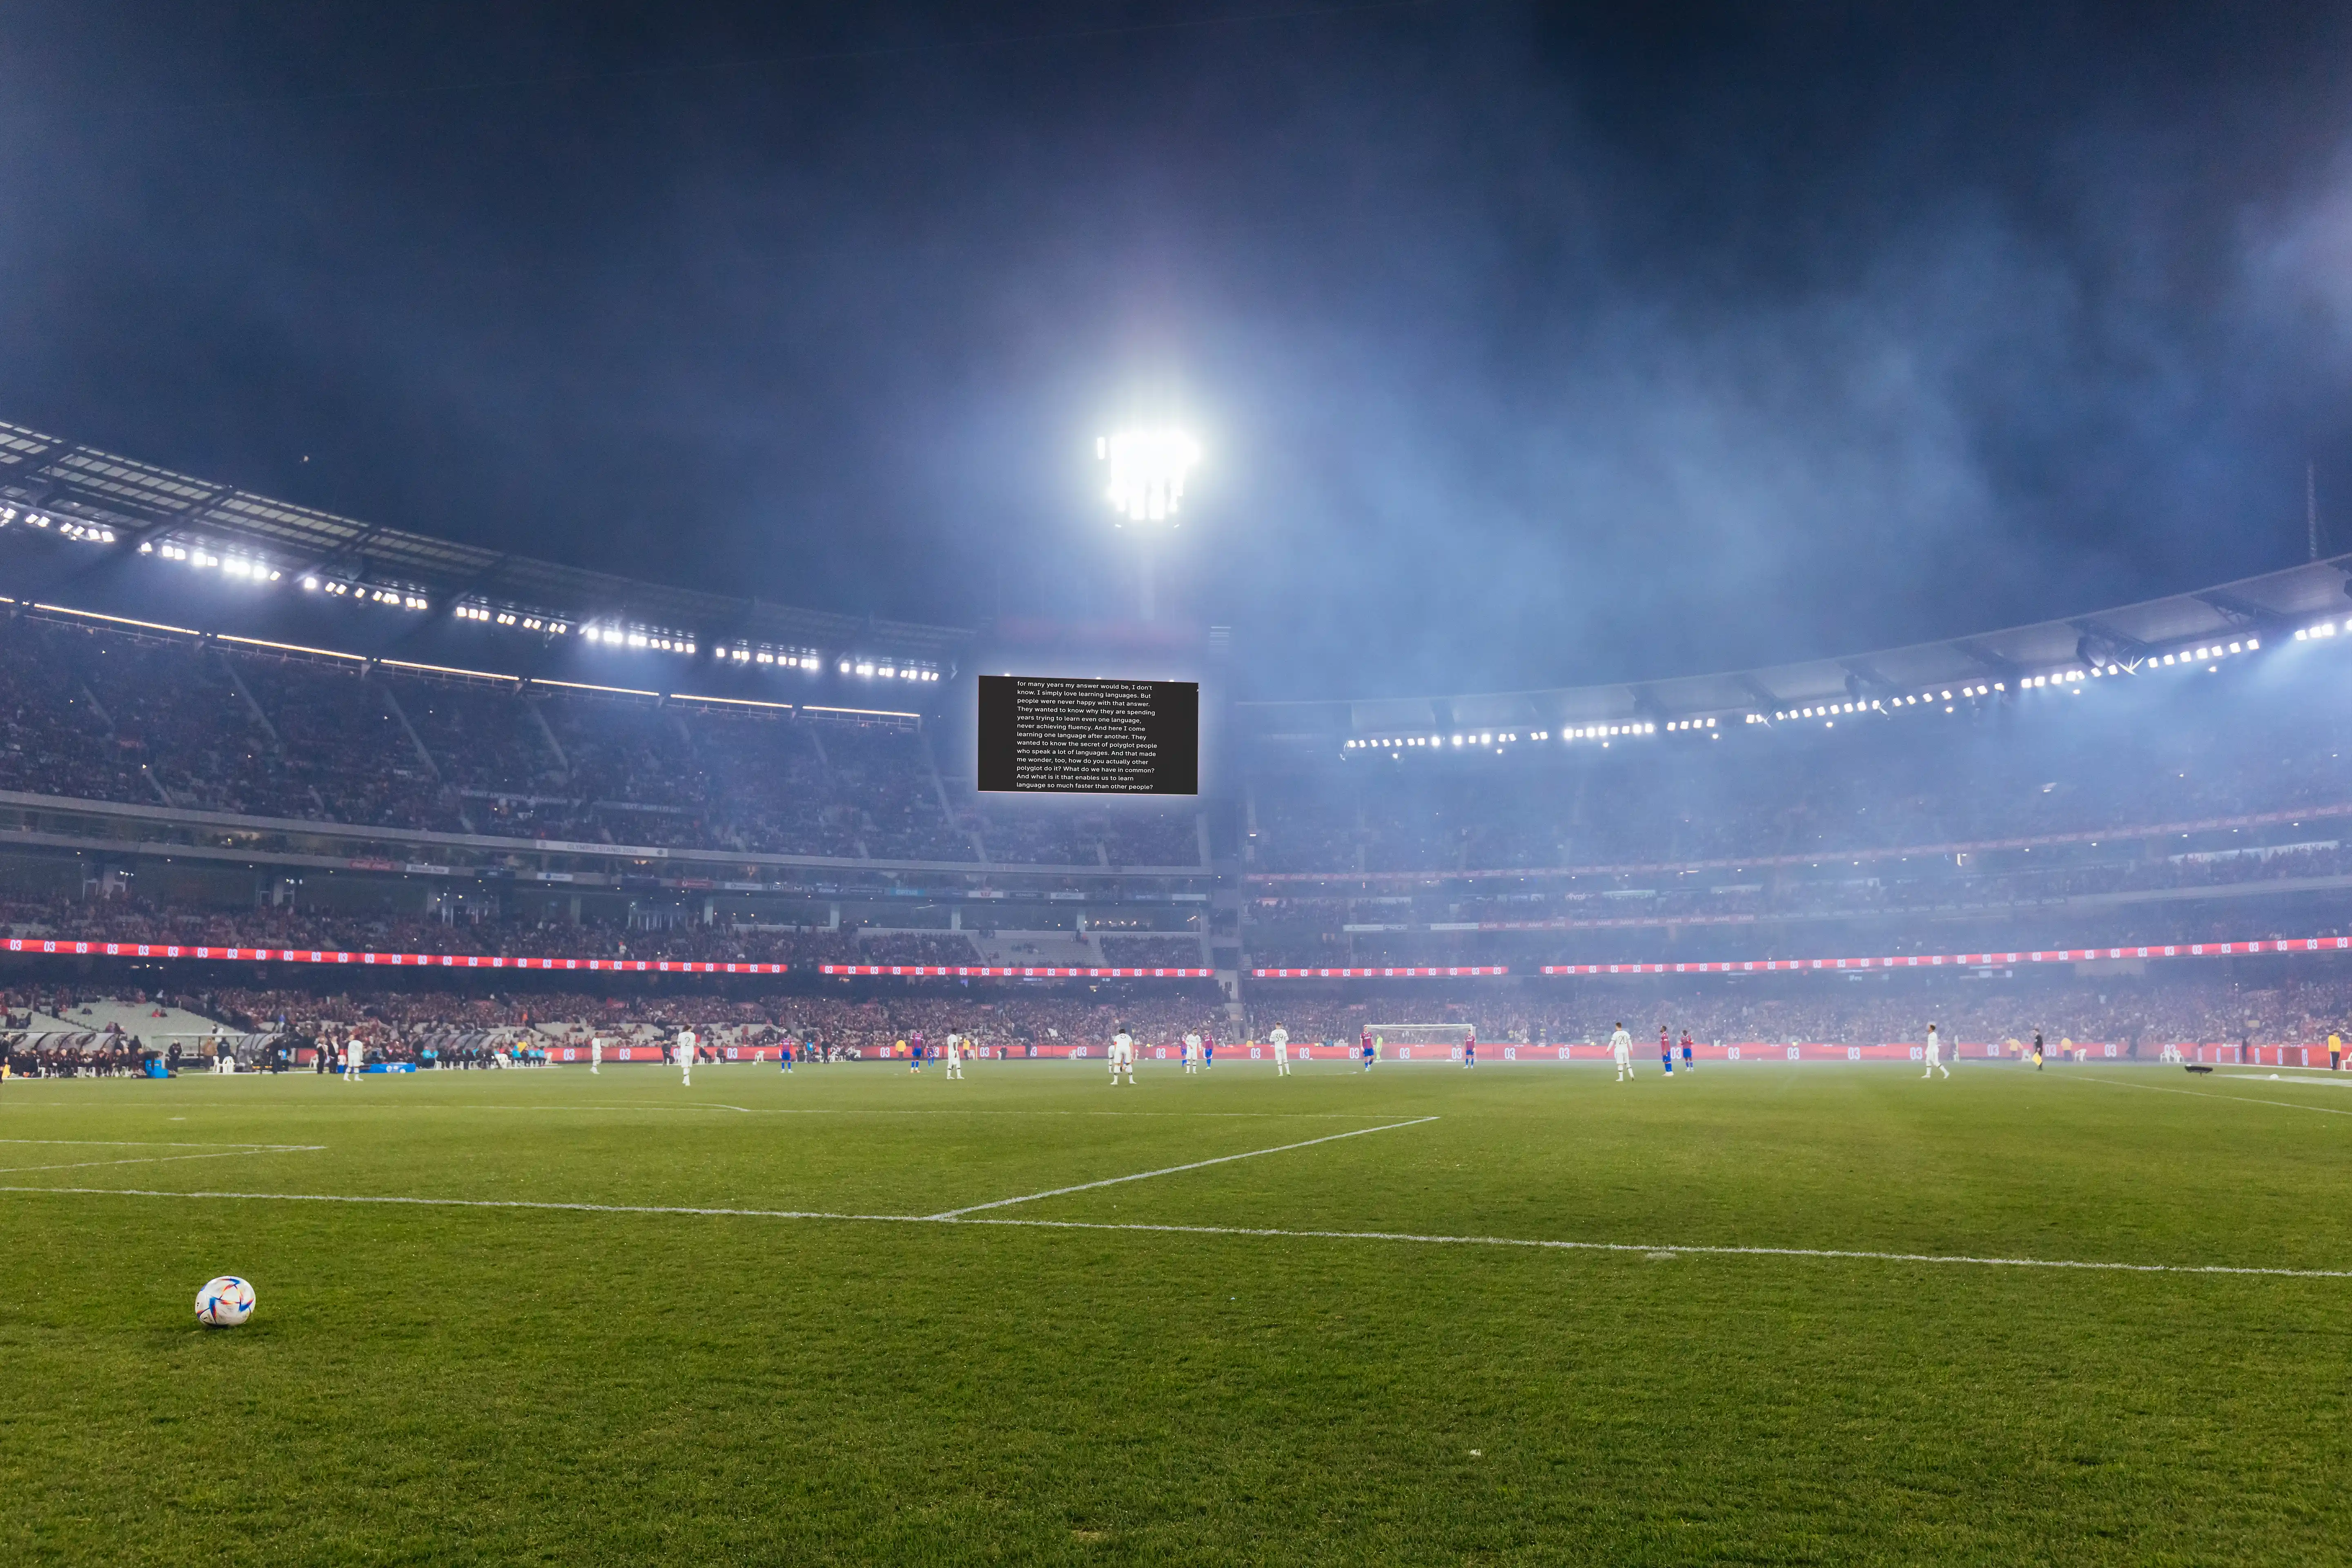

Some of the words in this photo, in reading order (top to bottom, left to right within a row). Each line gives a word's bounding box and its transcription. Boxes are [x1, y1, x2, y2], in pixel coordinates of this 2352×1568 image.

[10, 940, 22, 950] 03
[44, 942, 55, 951] 03
[2307, 940, 2317, 949] 03
[2337, 938, 2348, 948] 03
[138, 945, 149, 956] 03
[227, 949, 238, 958] 03
[284, 951, 293, 960] 03
[706, 963, 713, 971] 03
[685, 1037, 690, 1046] 2
[1275, 1033, 1283, 1042] 39
[1618, 1035, 1628, 1045] 20
[564, 1049, 575, 1060] 03
[619, 1049, 630, 1060] 03
[727, 1048, 737, 1058] 03
[880, 1047, 890, 1057] 03
[980, 1047, 989, 1056] 03
[1077, 1047, 1087, 1057] 03
[1156, 1048, 1165, 1058] 03
[1300, 1048, 1309, 1059] 03
[1350, 1048, 1359, 1059] 03
[1400, 1048, 1410, 1059] 03
[1452, 1048, 1461, 1059] 03
[1559, 1047, 1569, 1059] 03
[1670, 1047, 1682, 1059] 03
[1728, 1047, 1740, 1059] 03
[1788, 1047, 1799, 1059] 03
[1848, 1047, 1860, 1059] 03
[1910, 1047, 1922, 1060] 03
[2045, 1045, 2056, 1056] 03
